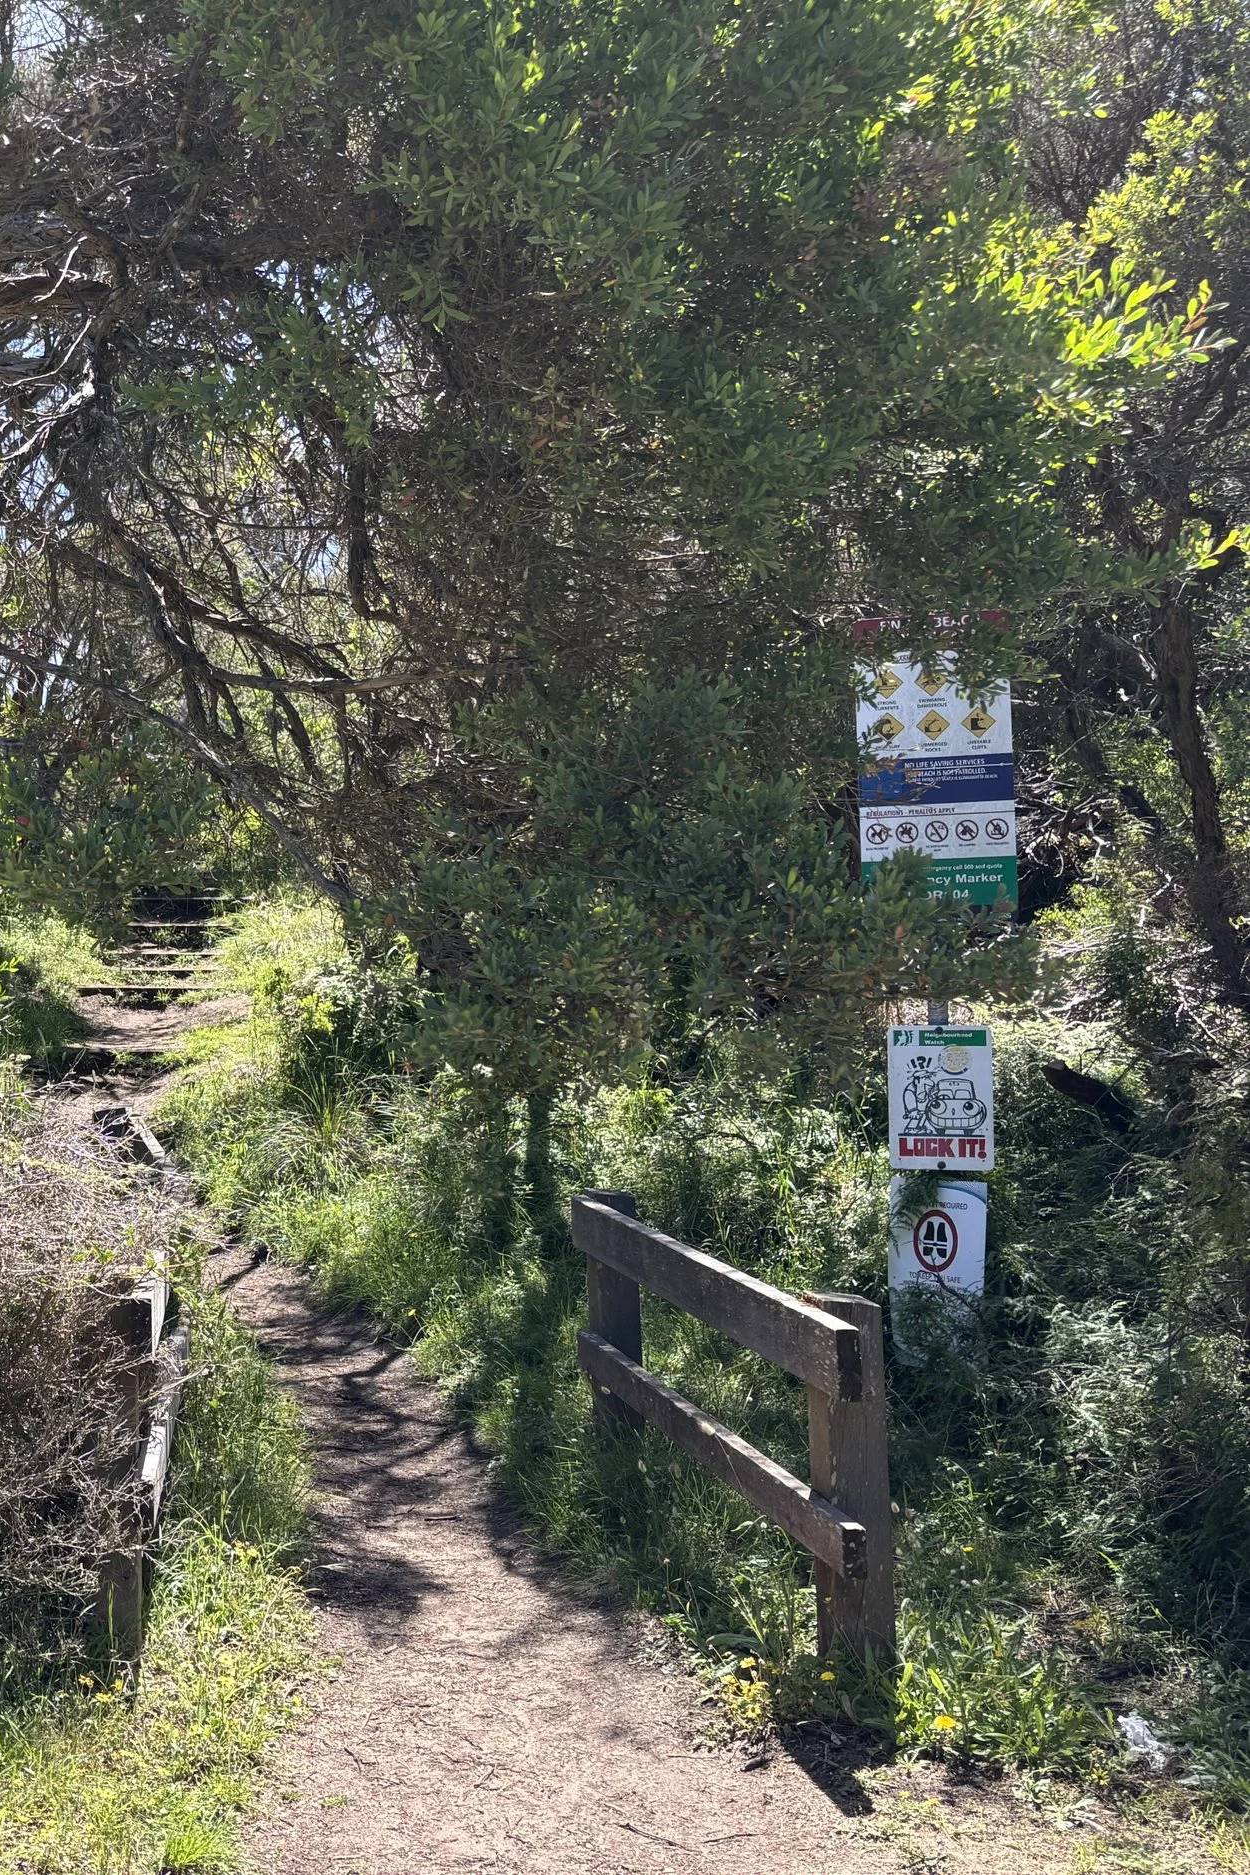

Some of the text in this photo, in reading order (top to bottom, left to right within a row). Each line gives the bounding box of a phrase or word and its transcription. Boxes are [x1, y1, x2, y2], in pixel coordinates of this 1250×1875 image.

[930, 760, 954, 768] SAVING
[955, 758, 985, 766] SERVICES
[908, 807, 937, 815] PENALTIES
[938, 806, 956, 814] APPLY
[986, 862, 1004, 870] quote
[955, 873, 1004, 884] Marker
[898, 1138, 987, 1159] LOCK IT!
[939, 1201, 968, 1210] REQUIRED
[946, 1275, 961, 1284] SAFE
